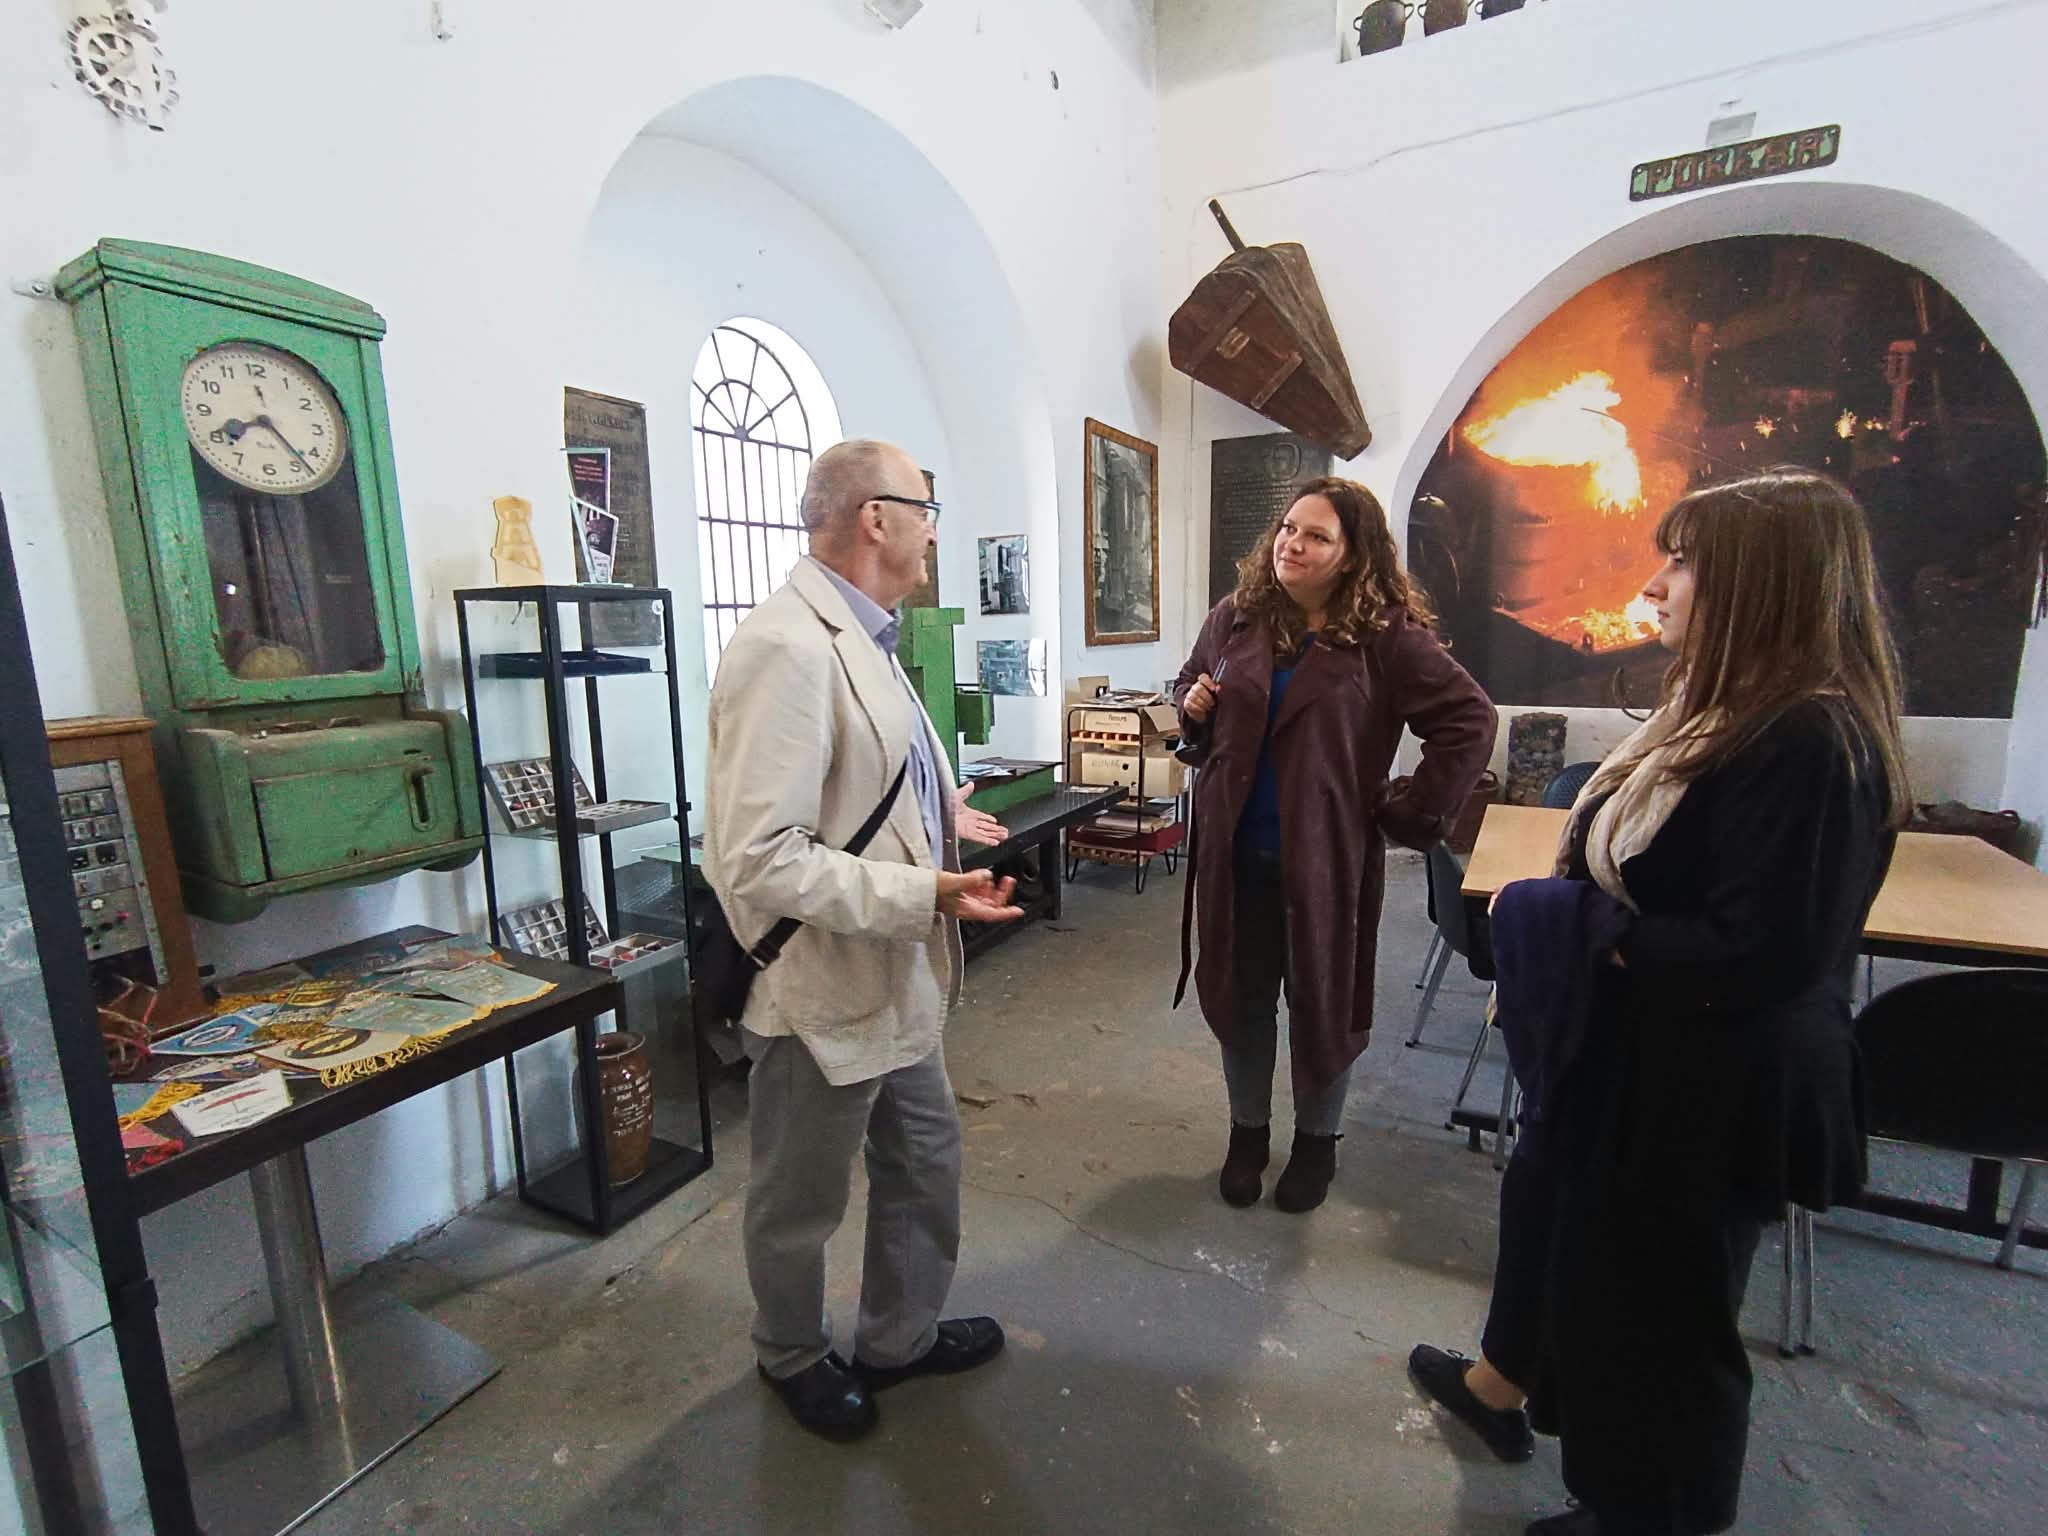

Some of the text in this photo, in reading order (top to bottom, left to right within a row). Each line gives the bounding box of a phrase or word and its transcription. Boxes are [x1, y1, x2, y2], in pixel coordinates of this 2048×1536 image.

[220, 365, 234, 379] 11
[245, 363, 266, 379] 12
[201, 380, 220, 394] 10
[282, 376, 289, 390] 1
[196, 403, 212, 416] 9
[299, 398, 312, 411] 2
[311, 423, 324, 436] 3
[210, 430, 224, 444] 8
[232, 451, 244, 466] 7
[308, 447, 320, 458] 4
[262, 463, 277, 476] 6
[289, 460, 301, 473] 5
